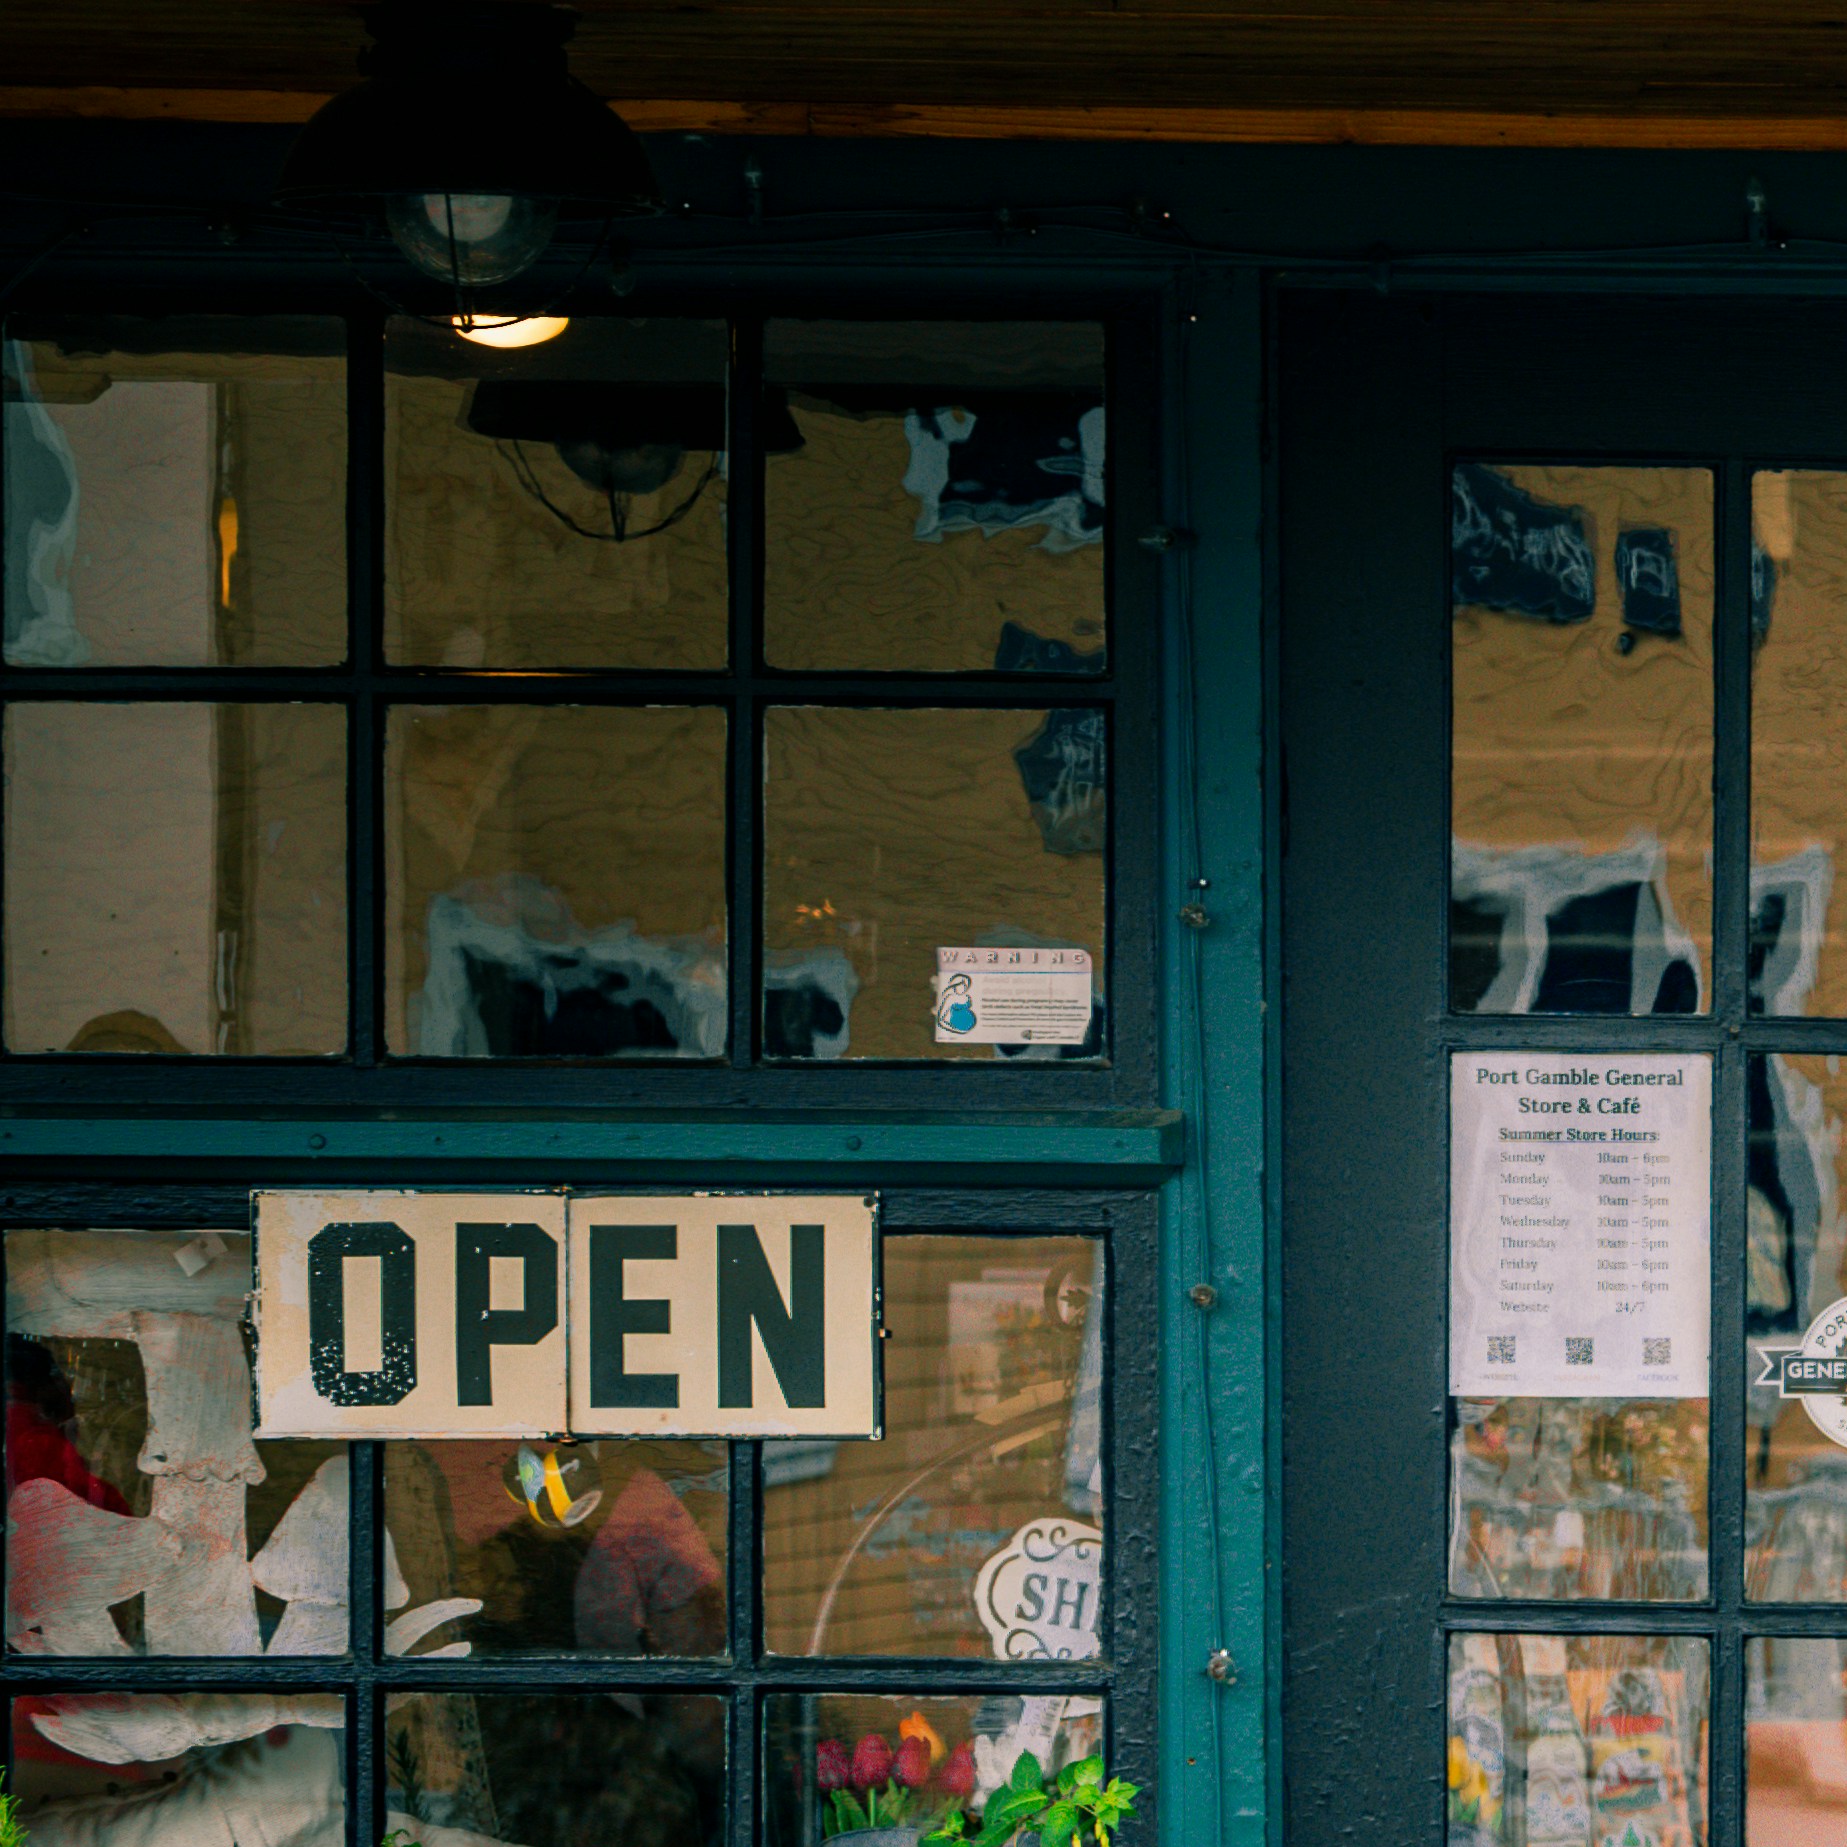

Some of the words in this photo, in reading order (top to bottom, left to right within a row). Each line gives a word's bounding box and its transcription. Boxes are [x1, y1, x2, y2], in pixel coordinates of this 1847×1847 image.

[1476, 1068, 1518, 1084] Port
[1526, 1068, 1599, 1086] Gamble
[1605, 1070, 1683, 1086] General
[1518, 1097, 1571, 1113] Store
[1577, 1099, 1591, 1113] &
[1597, 1097, 1640, 1113] Café
[1499, 1128, 1561, 1141] Summer
[1566, 1129, 1606, 1141] Store
[1611, 1129, 1659, 1141] Hours:
[1500, 1153, 1545, 1165] Sunday
[1500, 1174, 1549, 1186] Monday
[1500, 1260, 1537, 1272] Friday
[1500, 1281, 1554, 1293] Saturday
[1500, 1301, 1549, 1312] Website
[308, 1222, 825, 1410] OPEN
